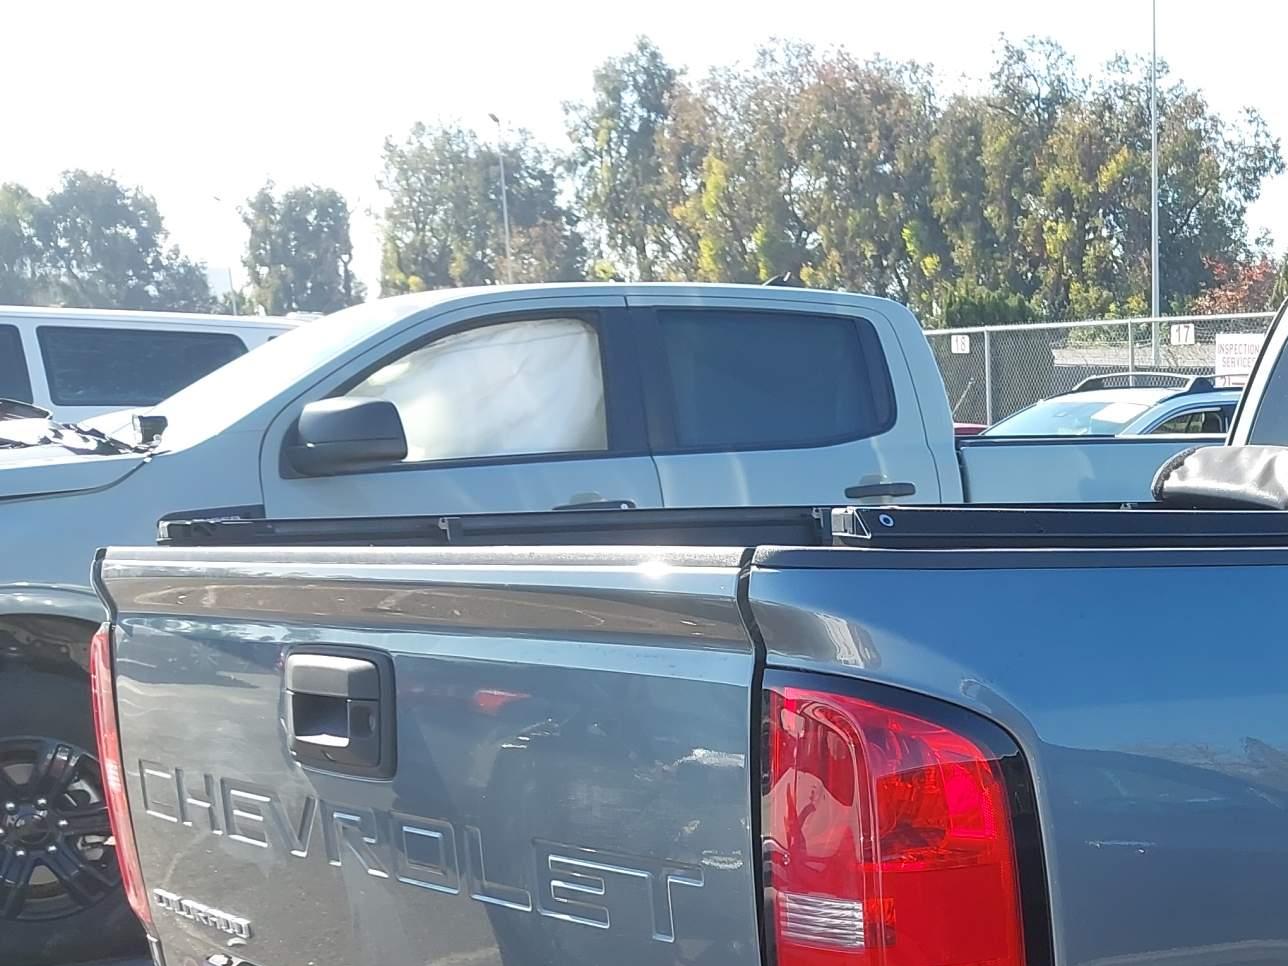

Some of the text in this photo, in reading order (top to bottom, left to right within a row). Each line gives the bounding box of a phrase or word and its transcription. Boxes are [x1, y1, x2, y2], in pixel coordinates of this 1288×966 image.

[1175, 324, 1190, 343] 17
[1217, 343, 1260, 355] INSPECTION
[138, 759, 706, 945] CHEVROLET
[153, 888, 252, 939] COLORADO
